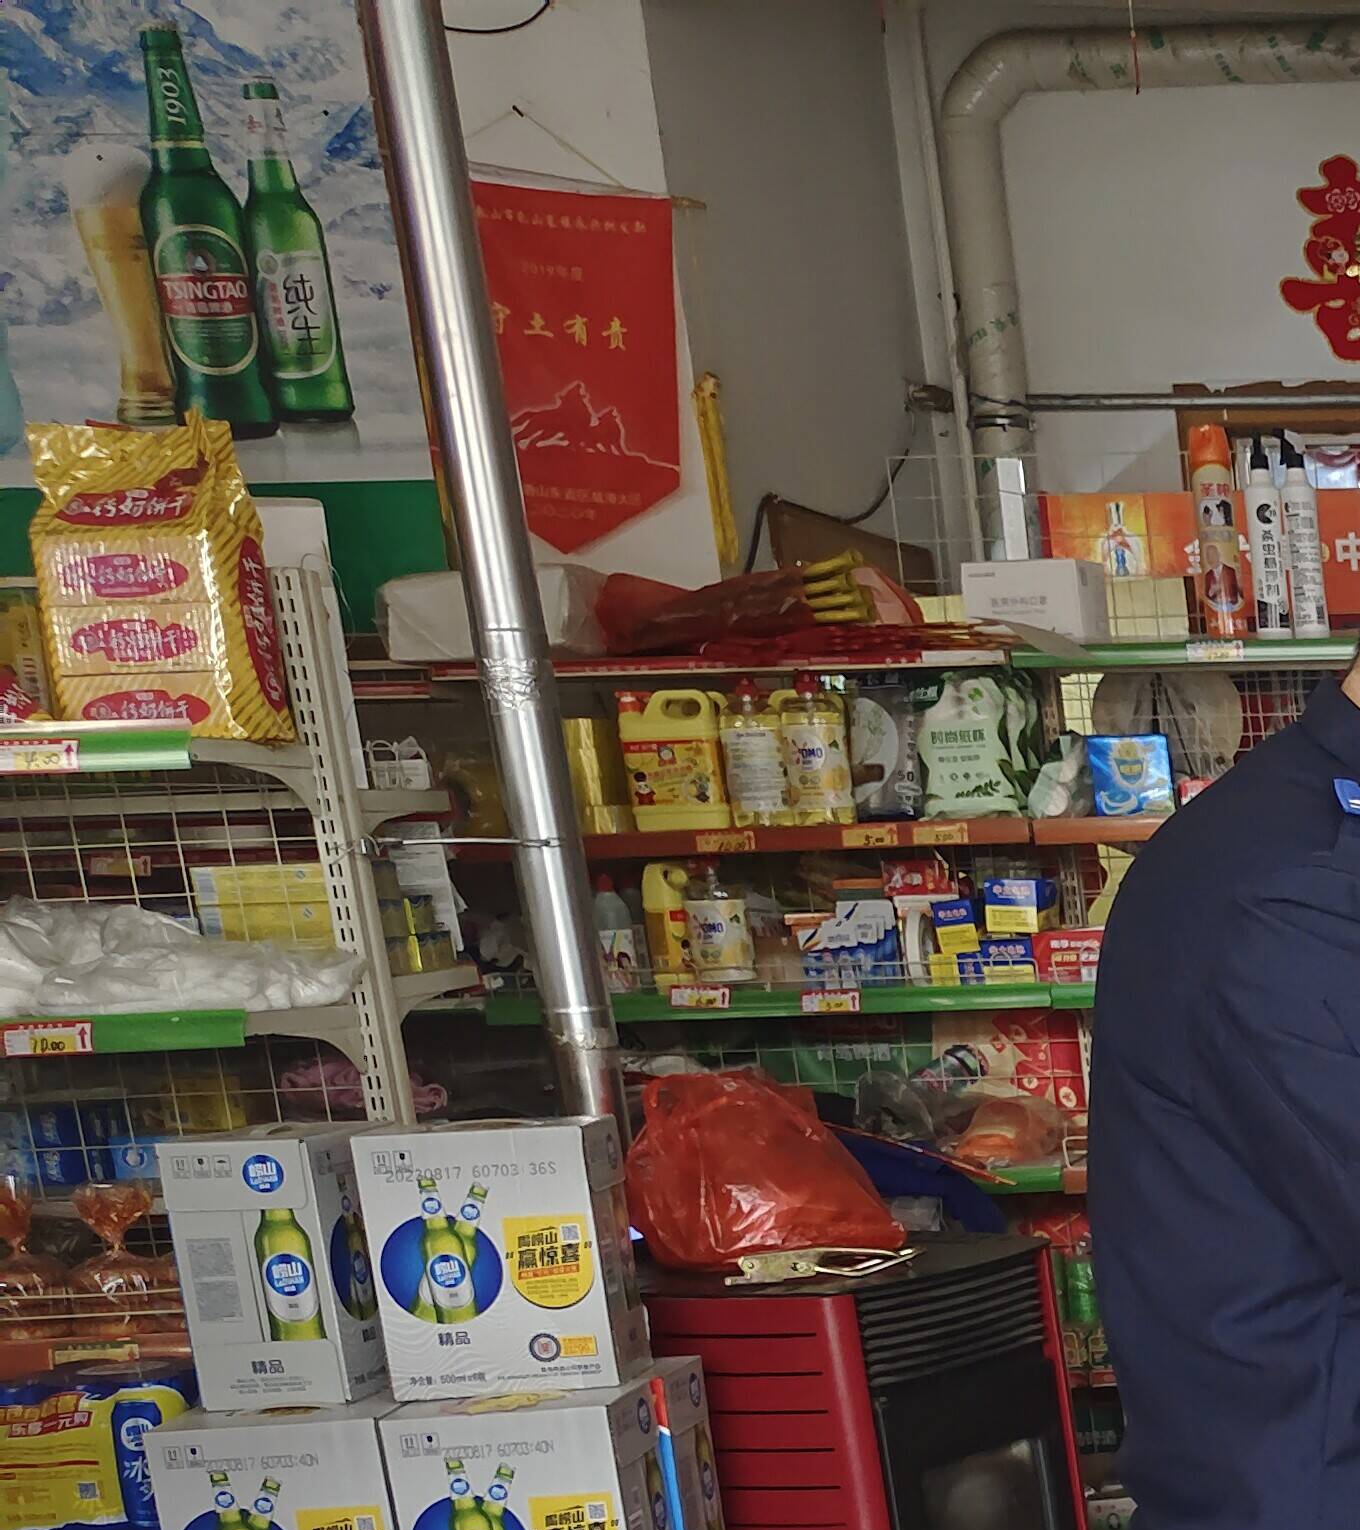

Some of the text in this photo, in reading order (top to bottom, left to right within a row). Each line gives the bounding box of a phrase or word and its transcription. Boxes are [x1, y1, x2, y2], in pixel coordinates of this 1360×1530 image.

[158, 67, 187, 126] 1903
[164, 277, 249, 301] TSINGTAO
[437, 1331, 472, 1347] 精品
[250, 1359, 285, 1375] 精品
